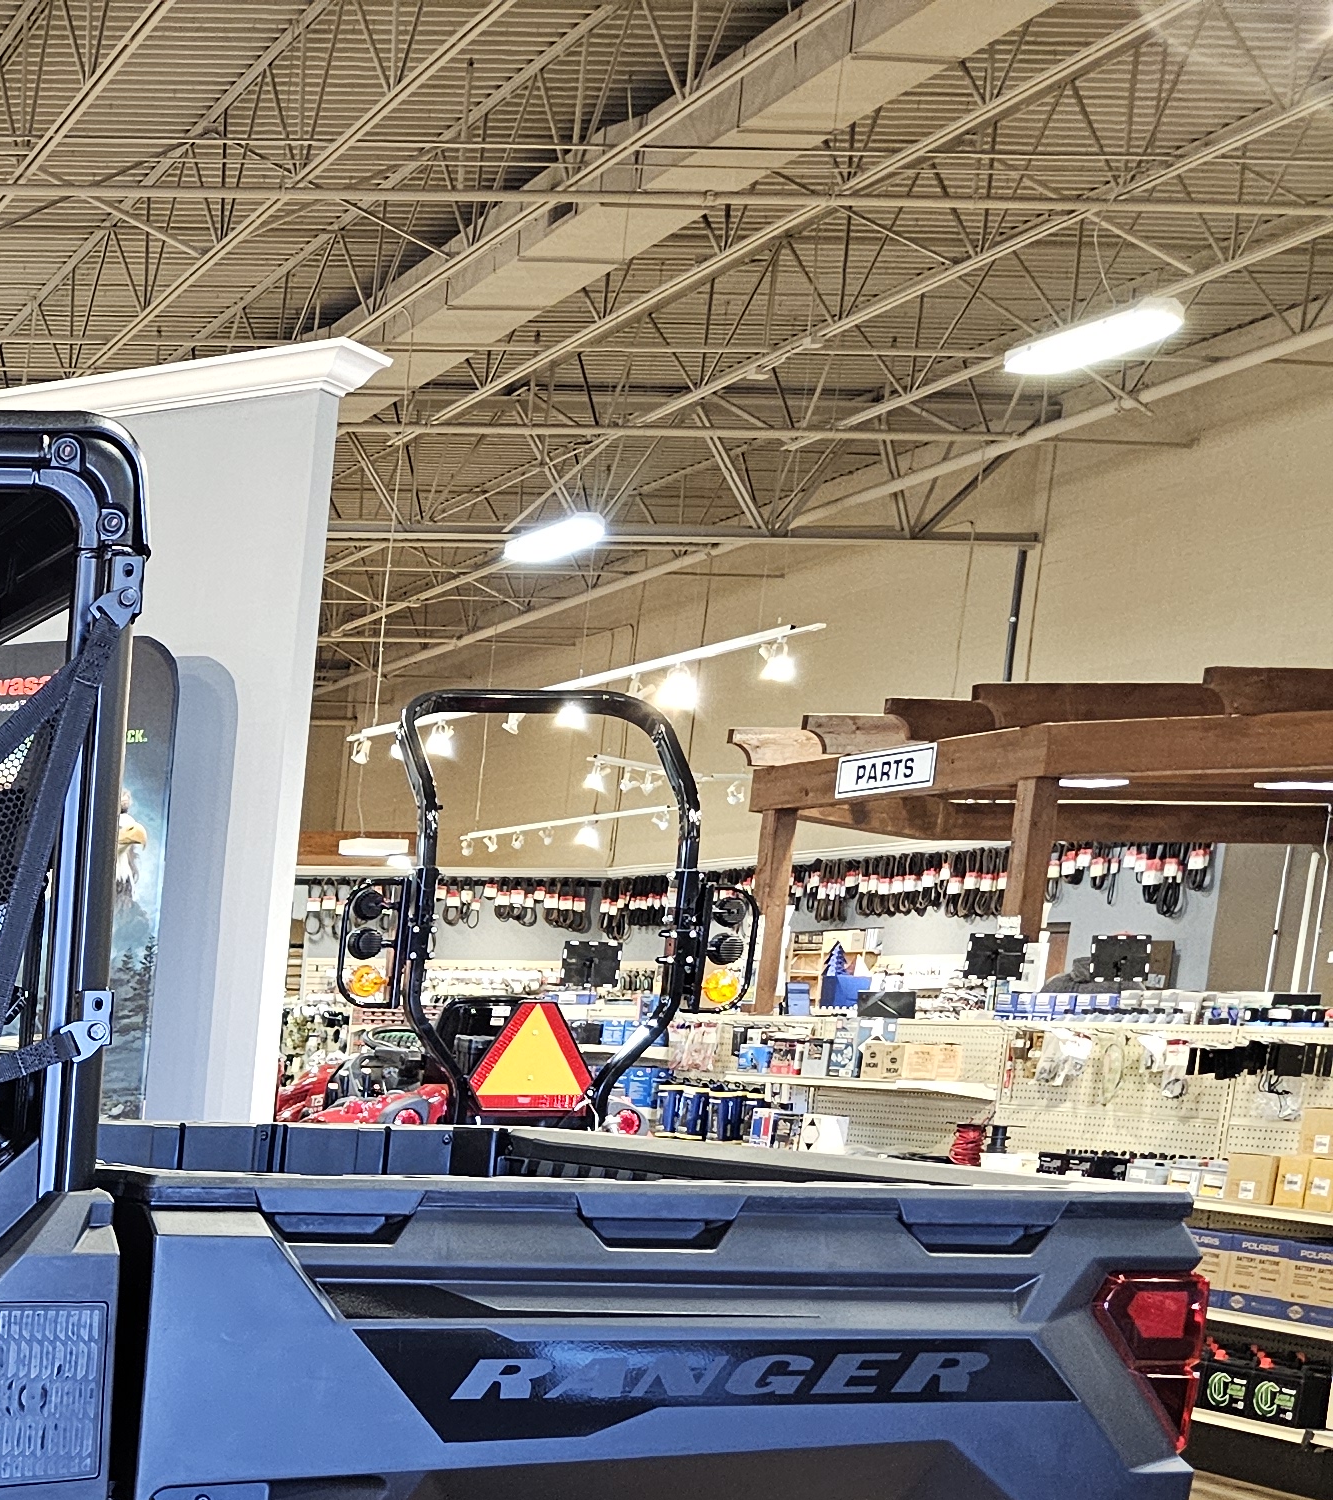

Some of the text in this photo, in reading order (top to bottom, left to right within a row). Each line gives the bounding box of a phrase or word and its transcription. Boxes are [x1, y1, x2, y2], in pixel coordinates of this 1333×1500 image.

[125, 729, 148, 744] CK.
[855, 757, 915, 785] PARTS
[1241, 1241, 1280, 1254] POLARIS
[1300, 1249, 1333, 1261] POLAR
[449, 1351, 990, 1400] RANGER
